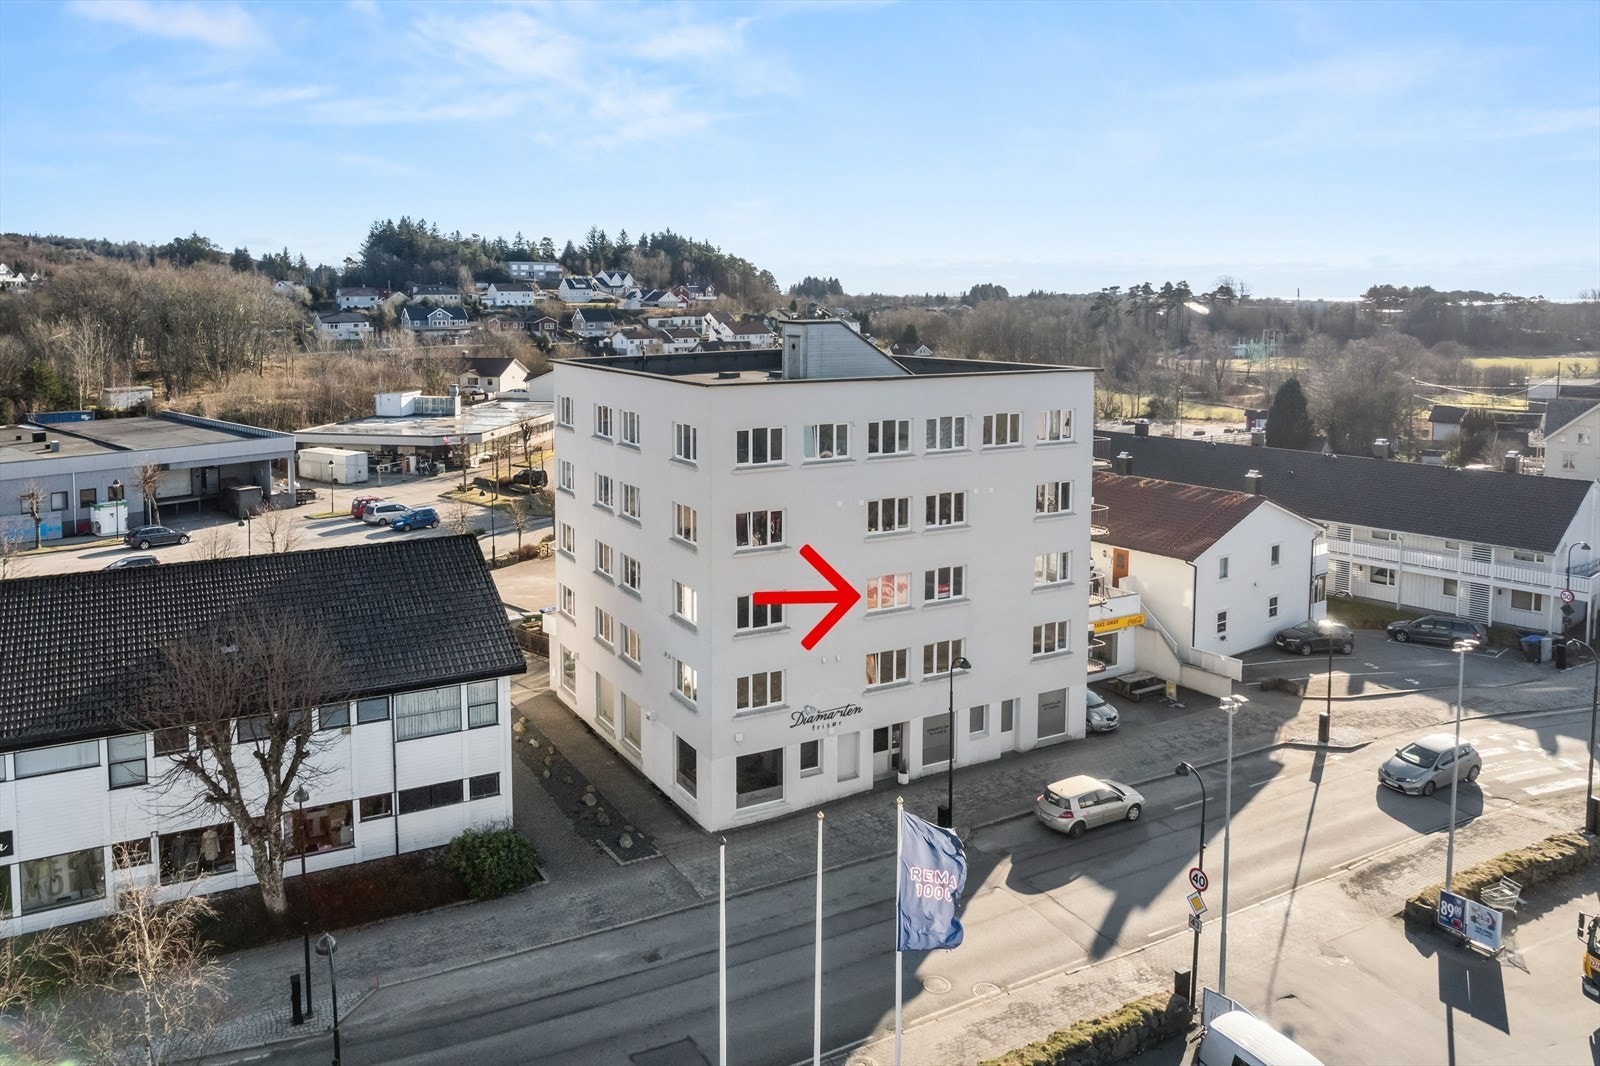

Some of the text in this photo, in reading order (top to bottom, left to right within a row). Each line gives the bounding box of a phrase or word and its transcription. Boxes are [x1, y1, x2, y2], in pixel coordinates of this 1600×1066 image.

[1106, 619, 1119, 627] AWAY
[911, 867, 957, 889] REMA
[1192, 873, 1205, 887] 40
[1190, 919, 1200, 929] 43
